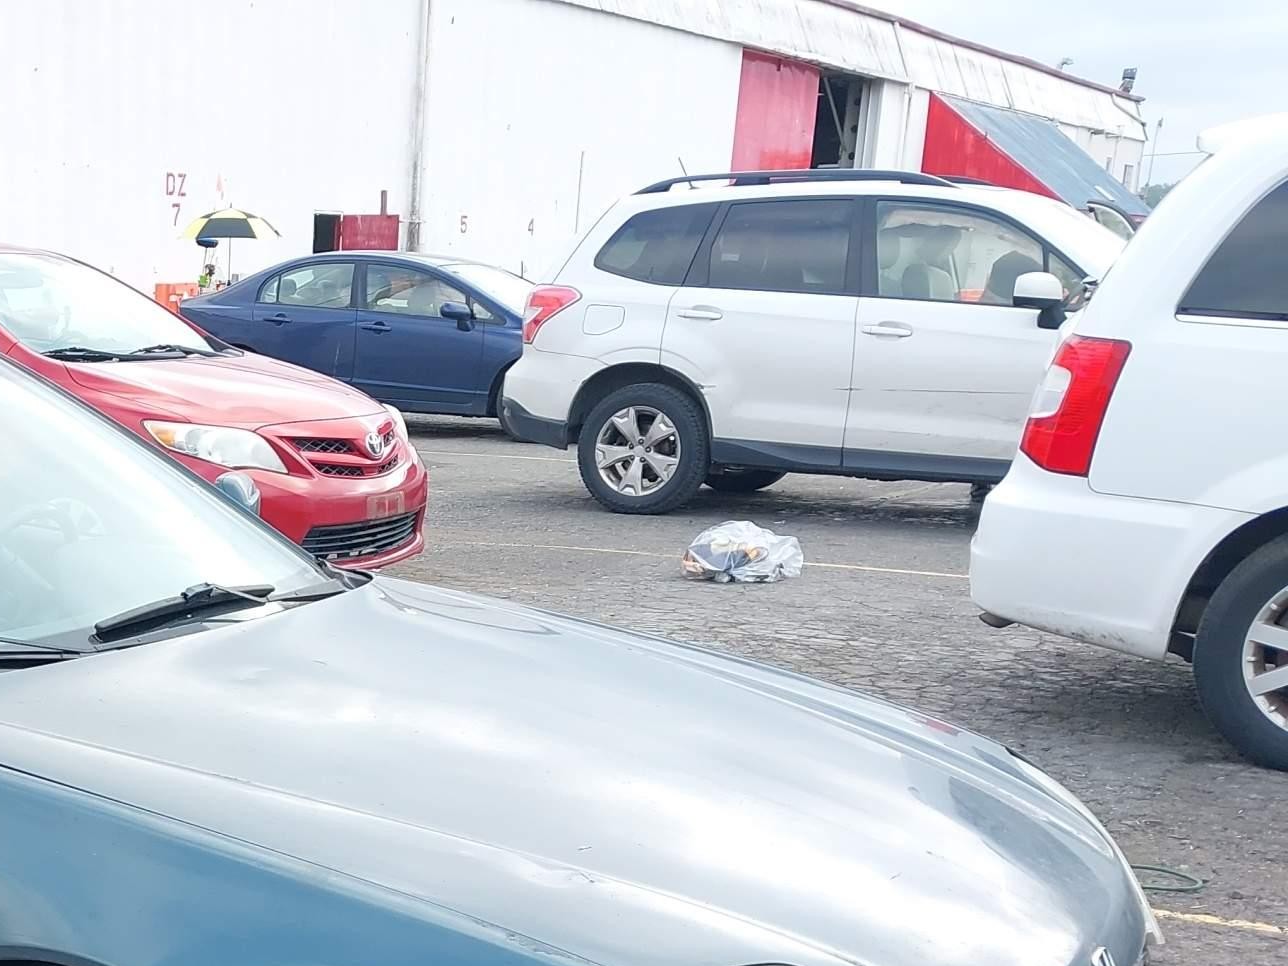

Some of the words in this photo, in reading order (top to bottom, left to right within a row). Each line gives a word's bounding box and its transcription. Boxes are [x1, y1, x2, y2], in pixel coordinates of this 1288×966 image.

[171, 203, 181, 227] 7
[460, 215, 468, 234] 5
[527, 218, 534, 237] 4
